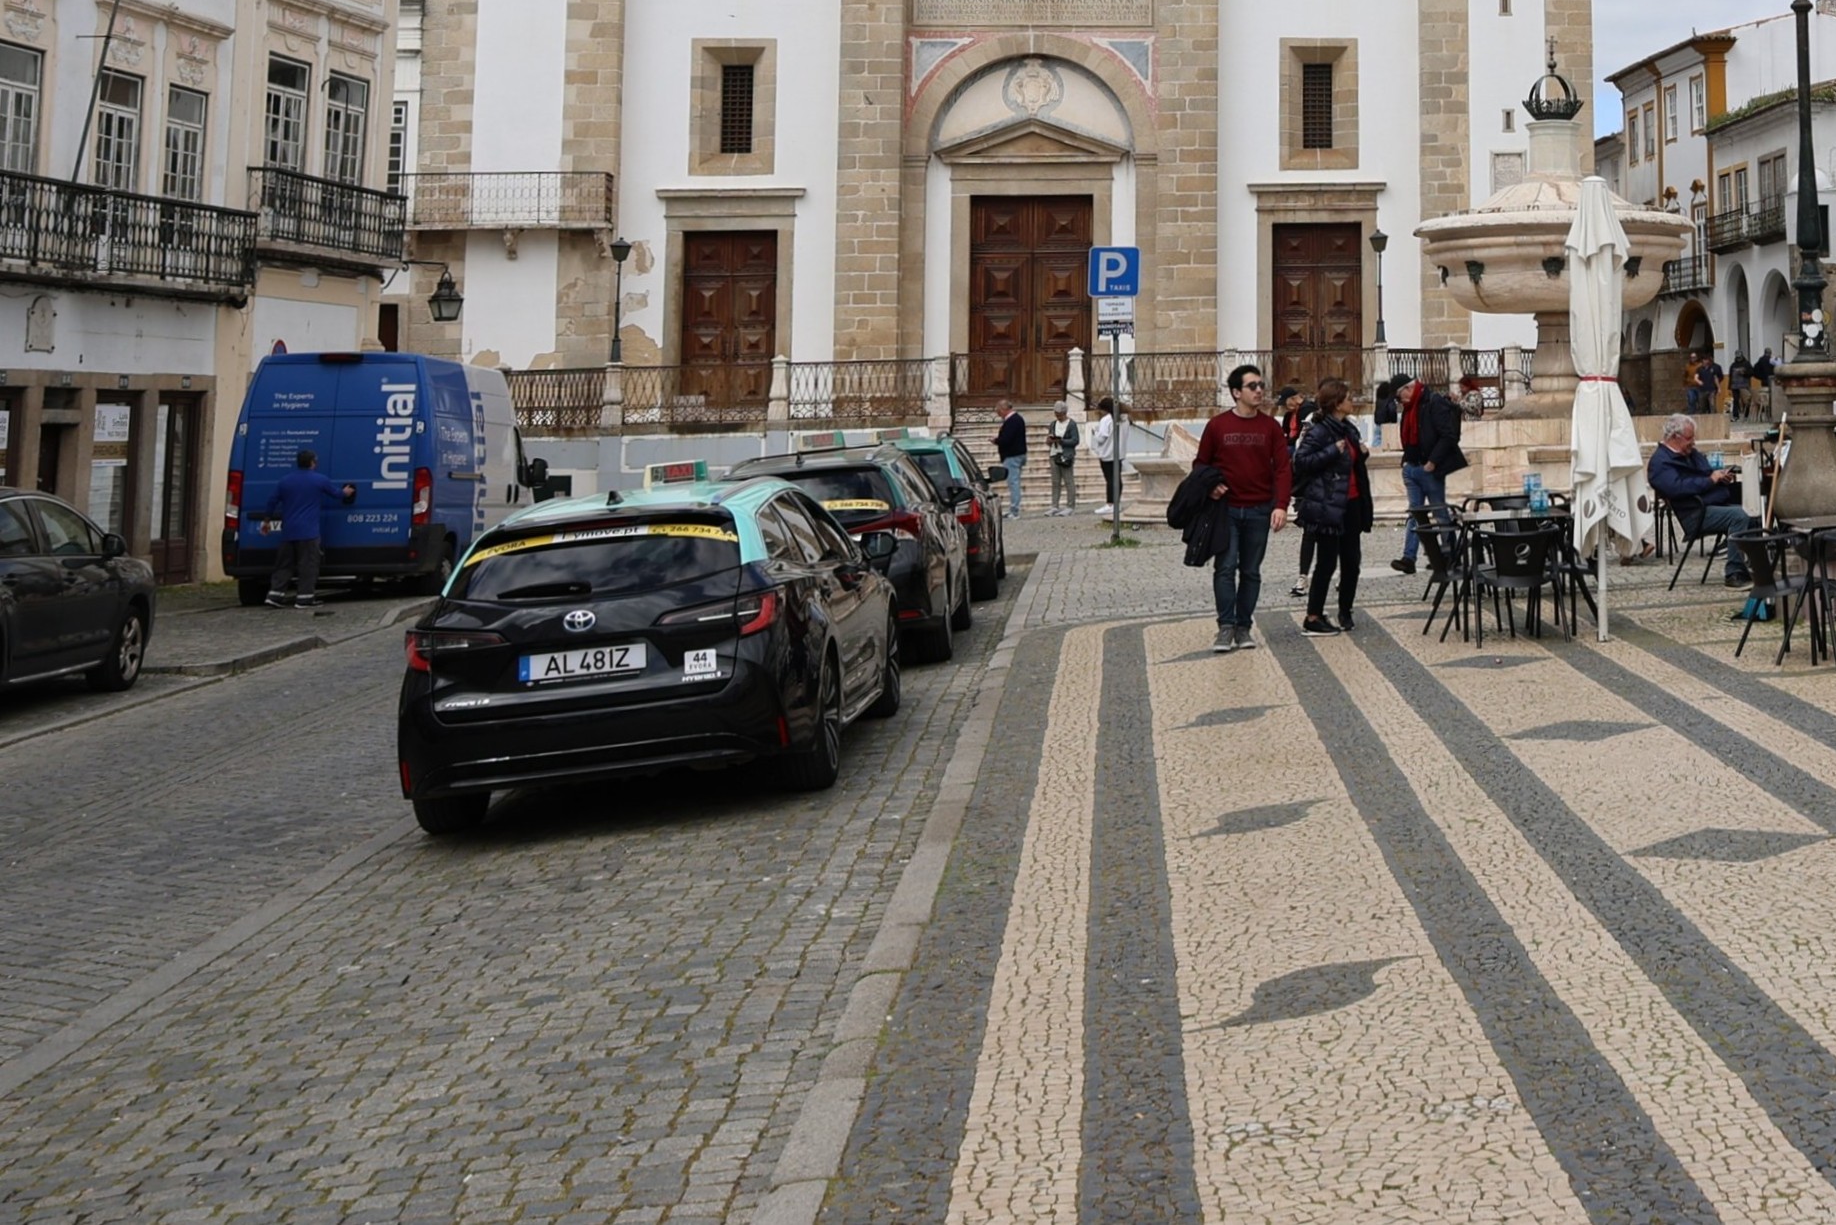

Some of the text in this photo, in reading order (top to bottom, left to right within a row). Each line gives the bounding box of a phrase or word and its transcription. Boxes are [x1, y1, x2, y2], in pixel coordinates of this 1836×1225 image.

[1097, 251, 1128, 292] P
[1109, 284, 1131, 292] TAXIS
[289, 393, 315, 401] Experts
[281, 402, 310, 410] Hygiene
[372, 384, 416, 489] Initial
[665, 464, 692, 479] TAXI
[347, 514, 398, 523] 808 223 224
[692, 526, 711, 534] 734
[693, 651, 708, 663] 44
[544, 654, 575, 676] AL
[579, 650, 606, 671] 48
